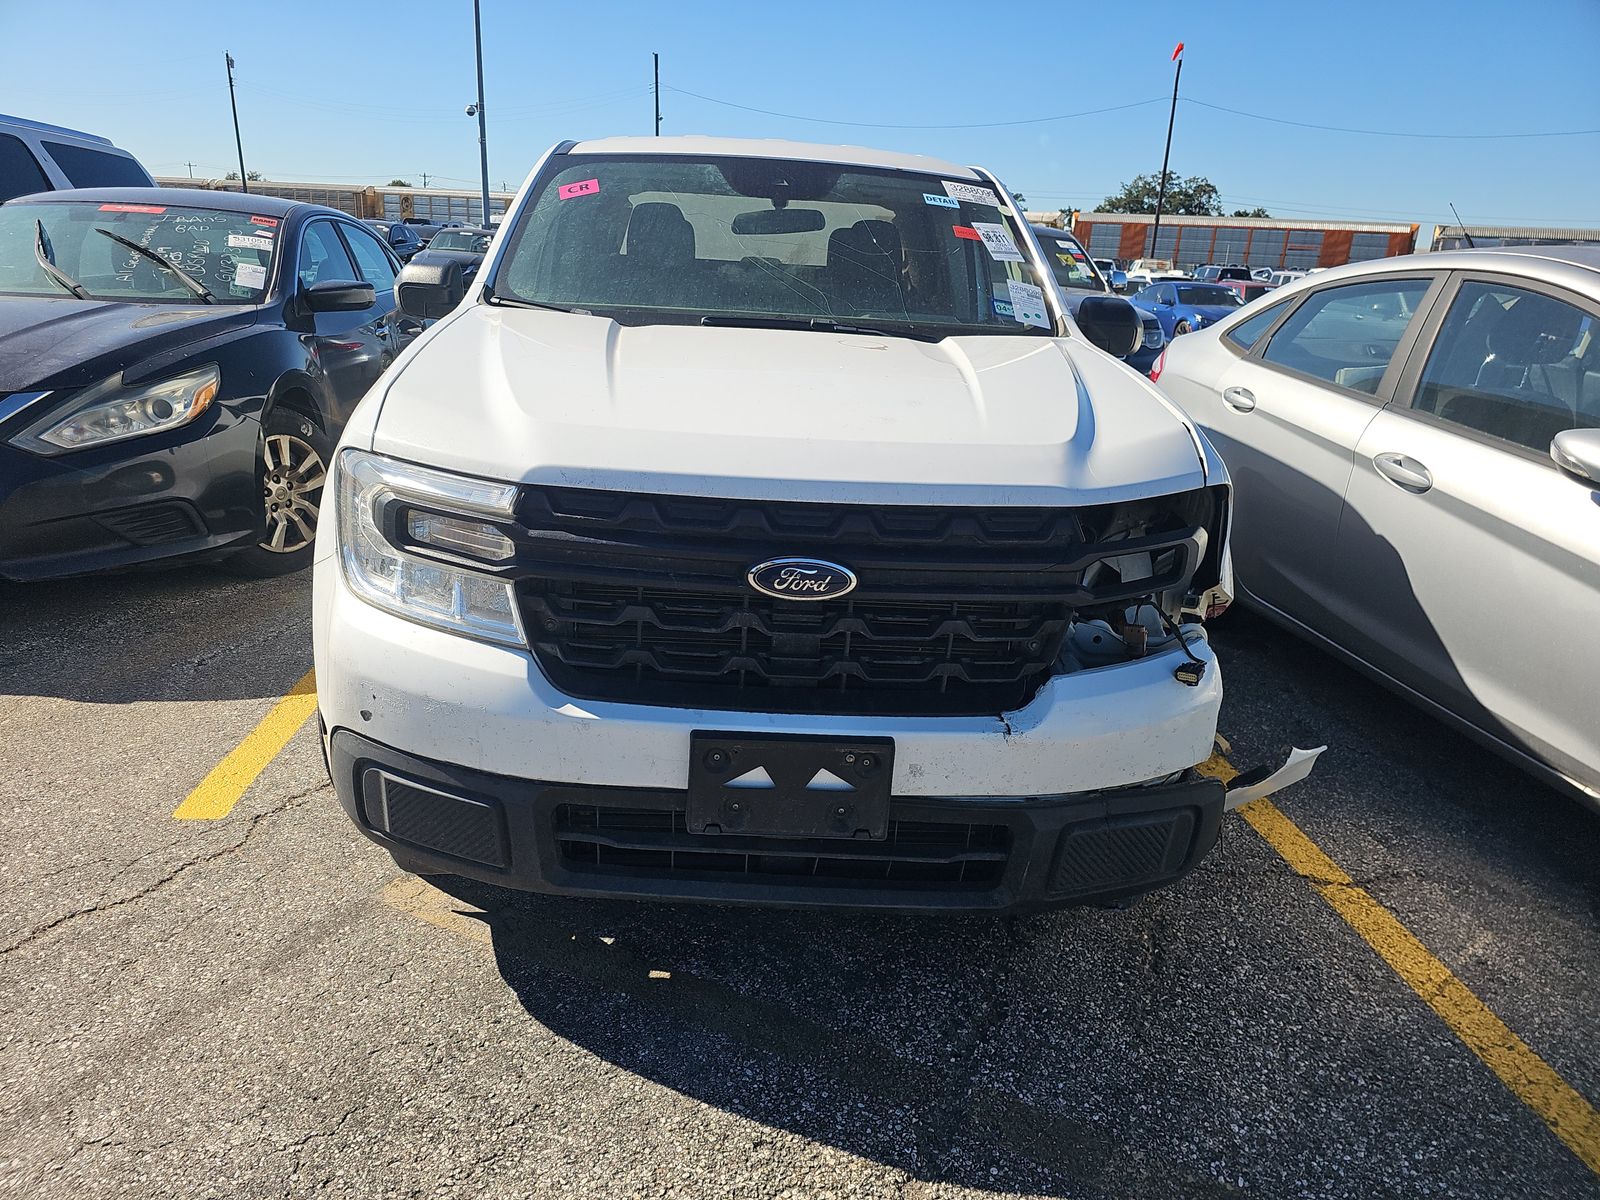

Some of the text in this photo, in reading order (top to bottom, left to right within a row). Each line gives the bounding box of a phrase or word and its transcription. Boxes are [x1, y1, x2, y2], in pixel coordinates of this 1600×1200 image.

[568, 184, 589, 193] CR
[926, 196, 957, 206] DETAIL
[175, 225, 210, 233] BAD
[774, 568, 831, 591] Ford
